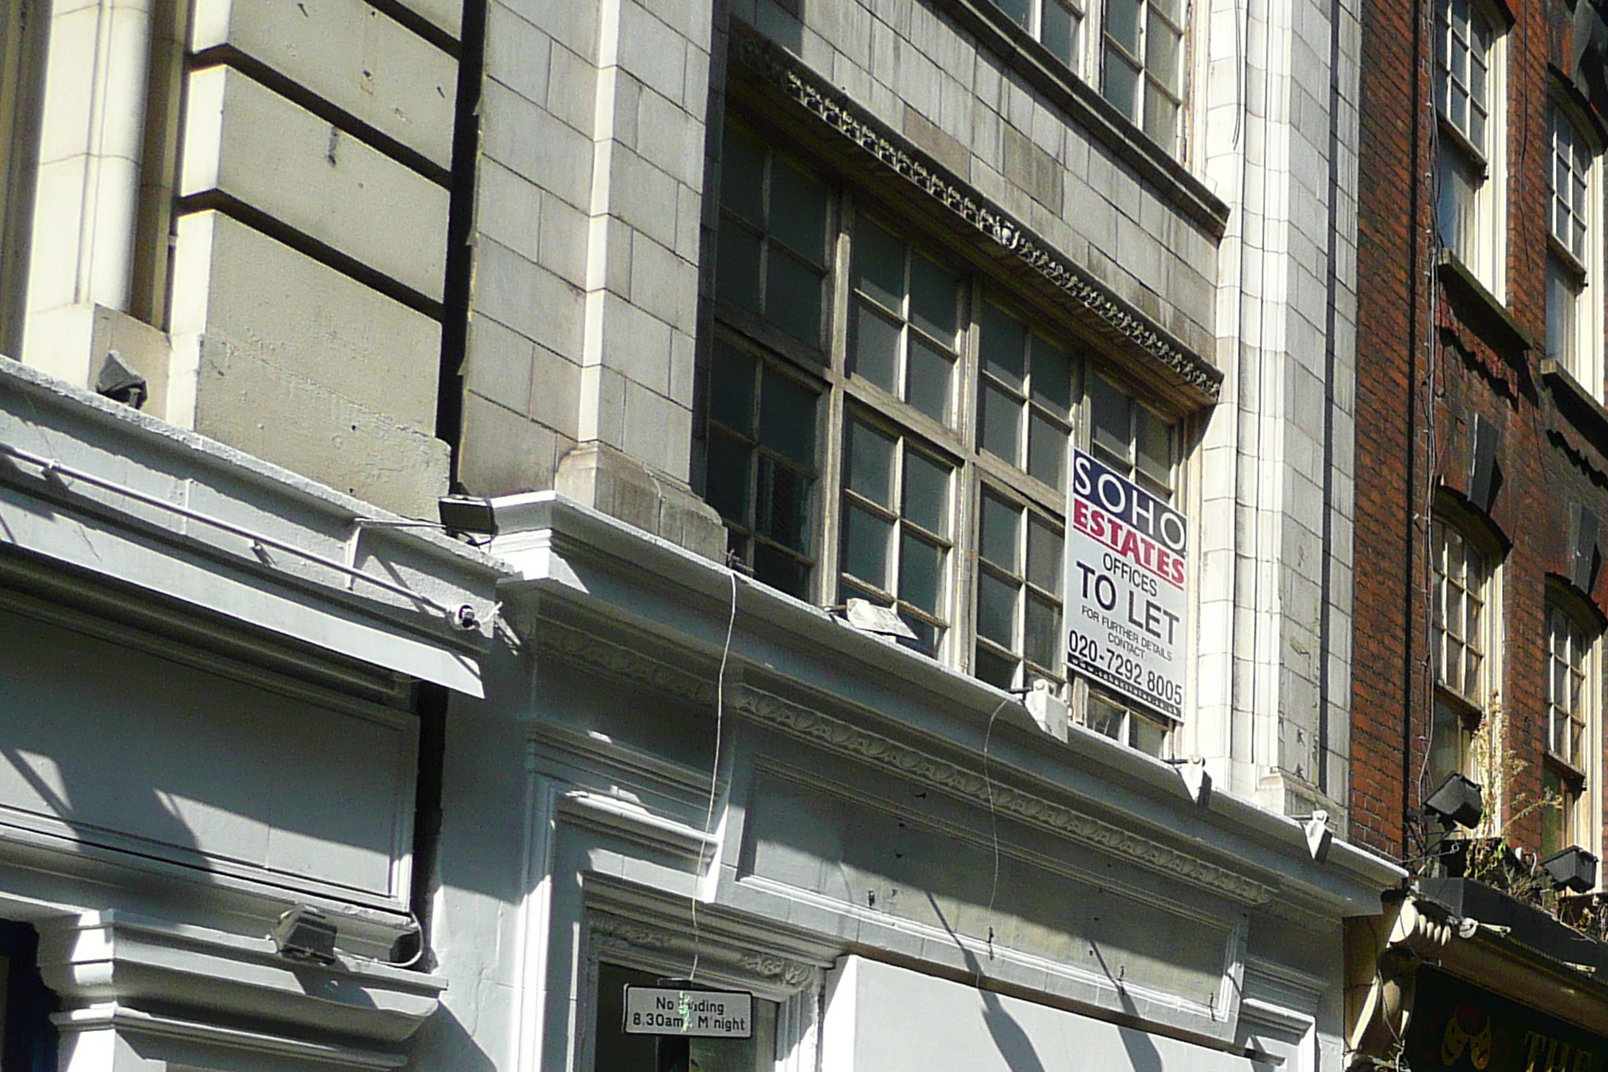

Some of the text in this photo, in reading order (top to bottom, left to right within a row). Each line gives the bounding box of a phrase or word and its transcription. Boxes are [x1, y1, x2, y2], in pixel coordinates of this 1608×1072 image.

[1075, 458, 1185, 550] SOHO
[1074, 499, 1185, 585] ESTATES
[1103, 554, 1158, 597] OFFICES
[1076, 561, 1179, 645] TO LET
[1082, 604, 1172, 662] FOR FURTHER DETAILS
[1068, 630, 1182, 706] 020-7292 8005
[1108, 633, 1145, 660] CONTACT
[656, 997, 674, 1010] No
